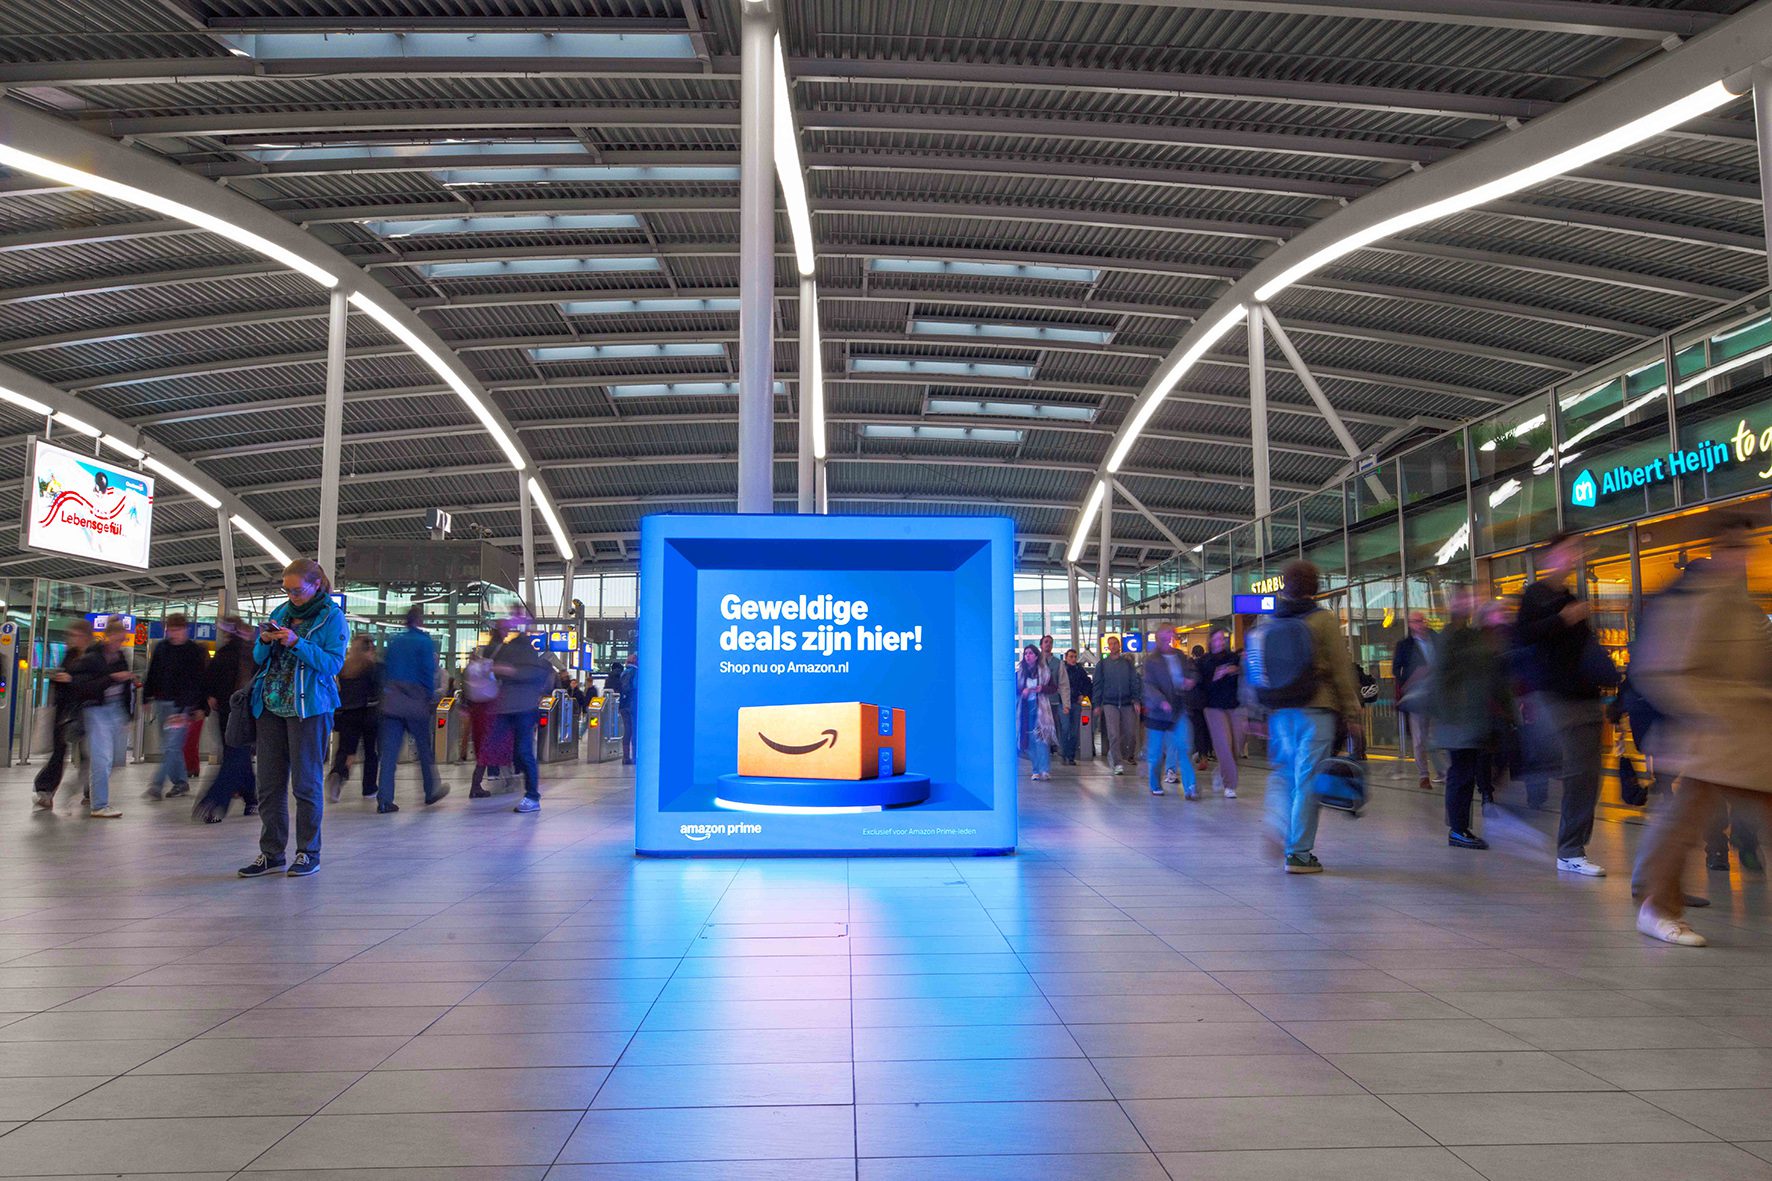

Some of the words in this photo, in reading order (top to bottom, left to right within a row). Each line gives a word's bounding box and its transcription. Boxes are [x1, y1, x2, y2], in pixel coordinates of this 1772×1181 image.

[1602, 458, 1664, 495] Albert
[1668, 440, 1729, 474] Heijn
[1730, 419, 1755, 462] to
[1251, 575, 1285, 594] STARBU
[720, 593, 869, 626] Geweldige
[719, 625, 797, 651] deals
[801, 624, 851, 657] zijn
[857, 624, 923, 652] hier!
[1126, 639, 1138, 652] C
[719, 661, 750, 675] Shop
[752, 662, 768, 673] nu
[769, 662, 786, 675] op
[787, 661, 849, 673] Amazon.nl
[680, 824, 726, 836] amazon
[727, 821, 763, 836] prime
[862, 828, 892, 836] Exclusief
[908, 828, 936, 836] Amazon
